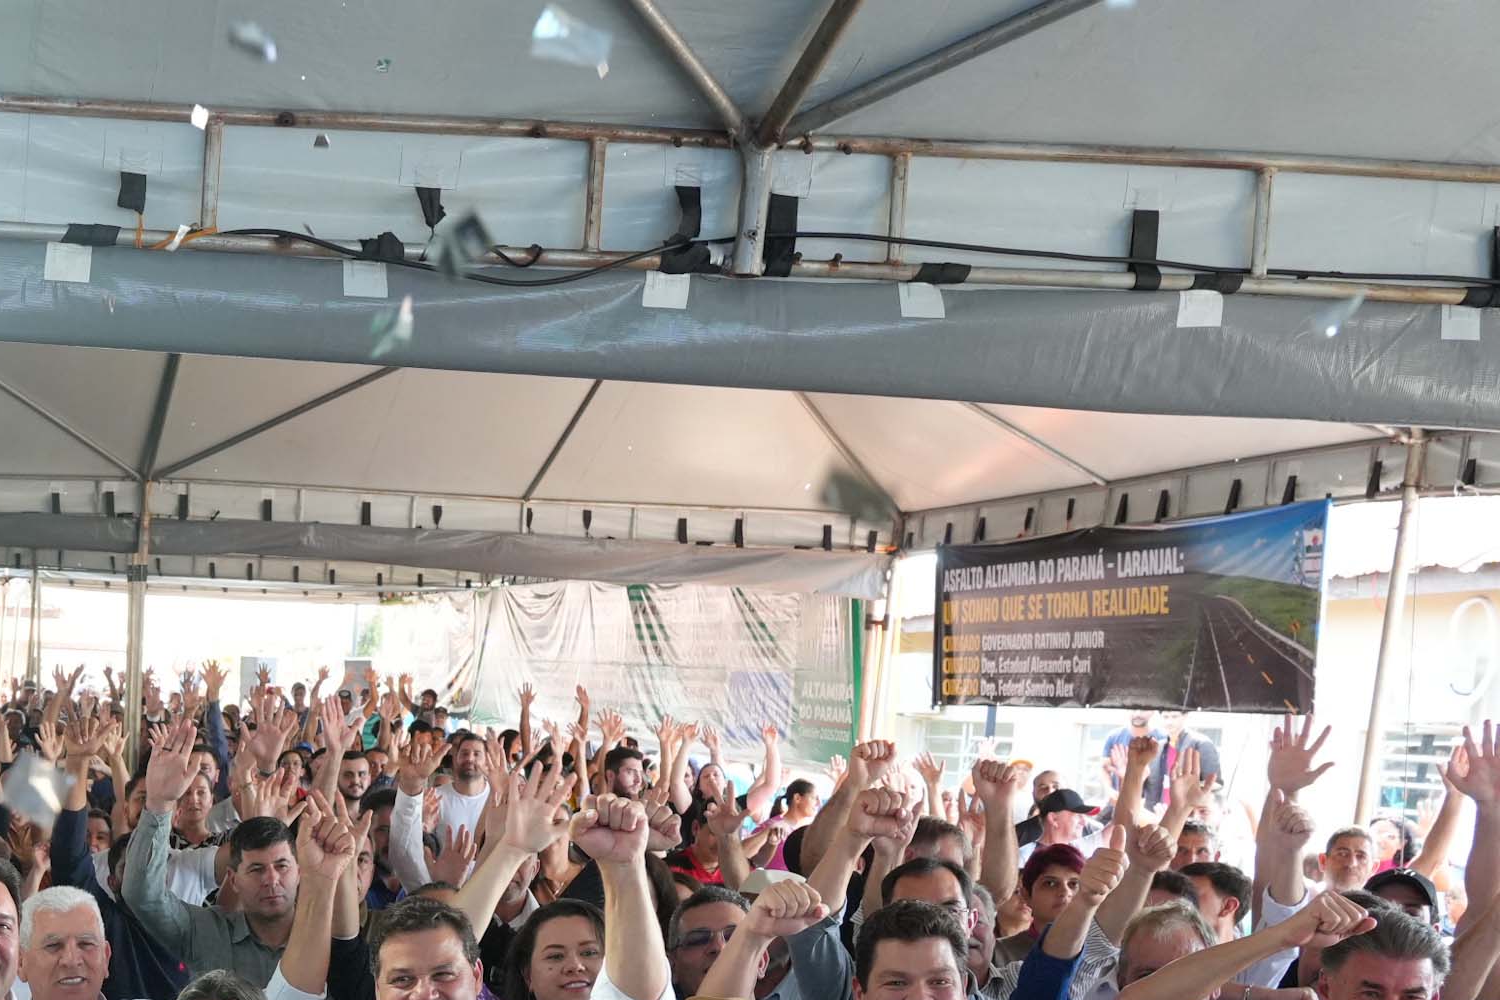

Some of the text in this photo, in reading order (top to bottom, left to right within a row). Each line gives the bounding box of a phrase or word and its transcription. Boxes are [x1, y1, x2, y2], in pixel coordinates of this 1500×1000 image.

[943, 566, 983, 593] ASFALTO
[985, 560, 1036, 589] ALTAMIRA
[1039, 558, 1054, 584] DO
[1057, 548, 1104, 583] PARANÁ
[1117, 547, 1185, 578] LARANJAL:
[943, 585, 1169, 625] UM SONHO QUE SE TORNA REALIDADE
[981, 632, 1033, 651] GOVERNADOR
[1035, 631, 1071, 649] RATINHO
[1072, 630, 1105, 649] JUNIOR
[981, 656, 997, 677] Dep.
[998, 656, 1031, 673] Estadual
[1031, 655, 1071, 673] Alexandre
[1072, 655, 1092, 674] Curi
[980, 678, 997, 699] Dep.
[998, 678, 1025, 696] Federal
[1026, 678, 1054, 697] Sandro
[1055, 680, 1074, 697] Alex
